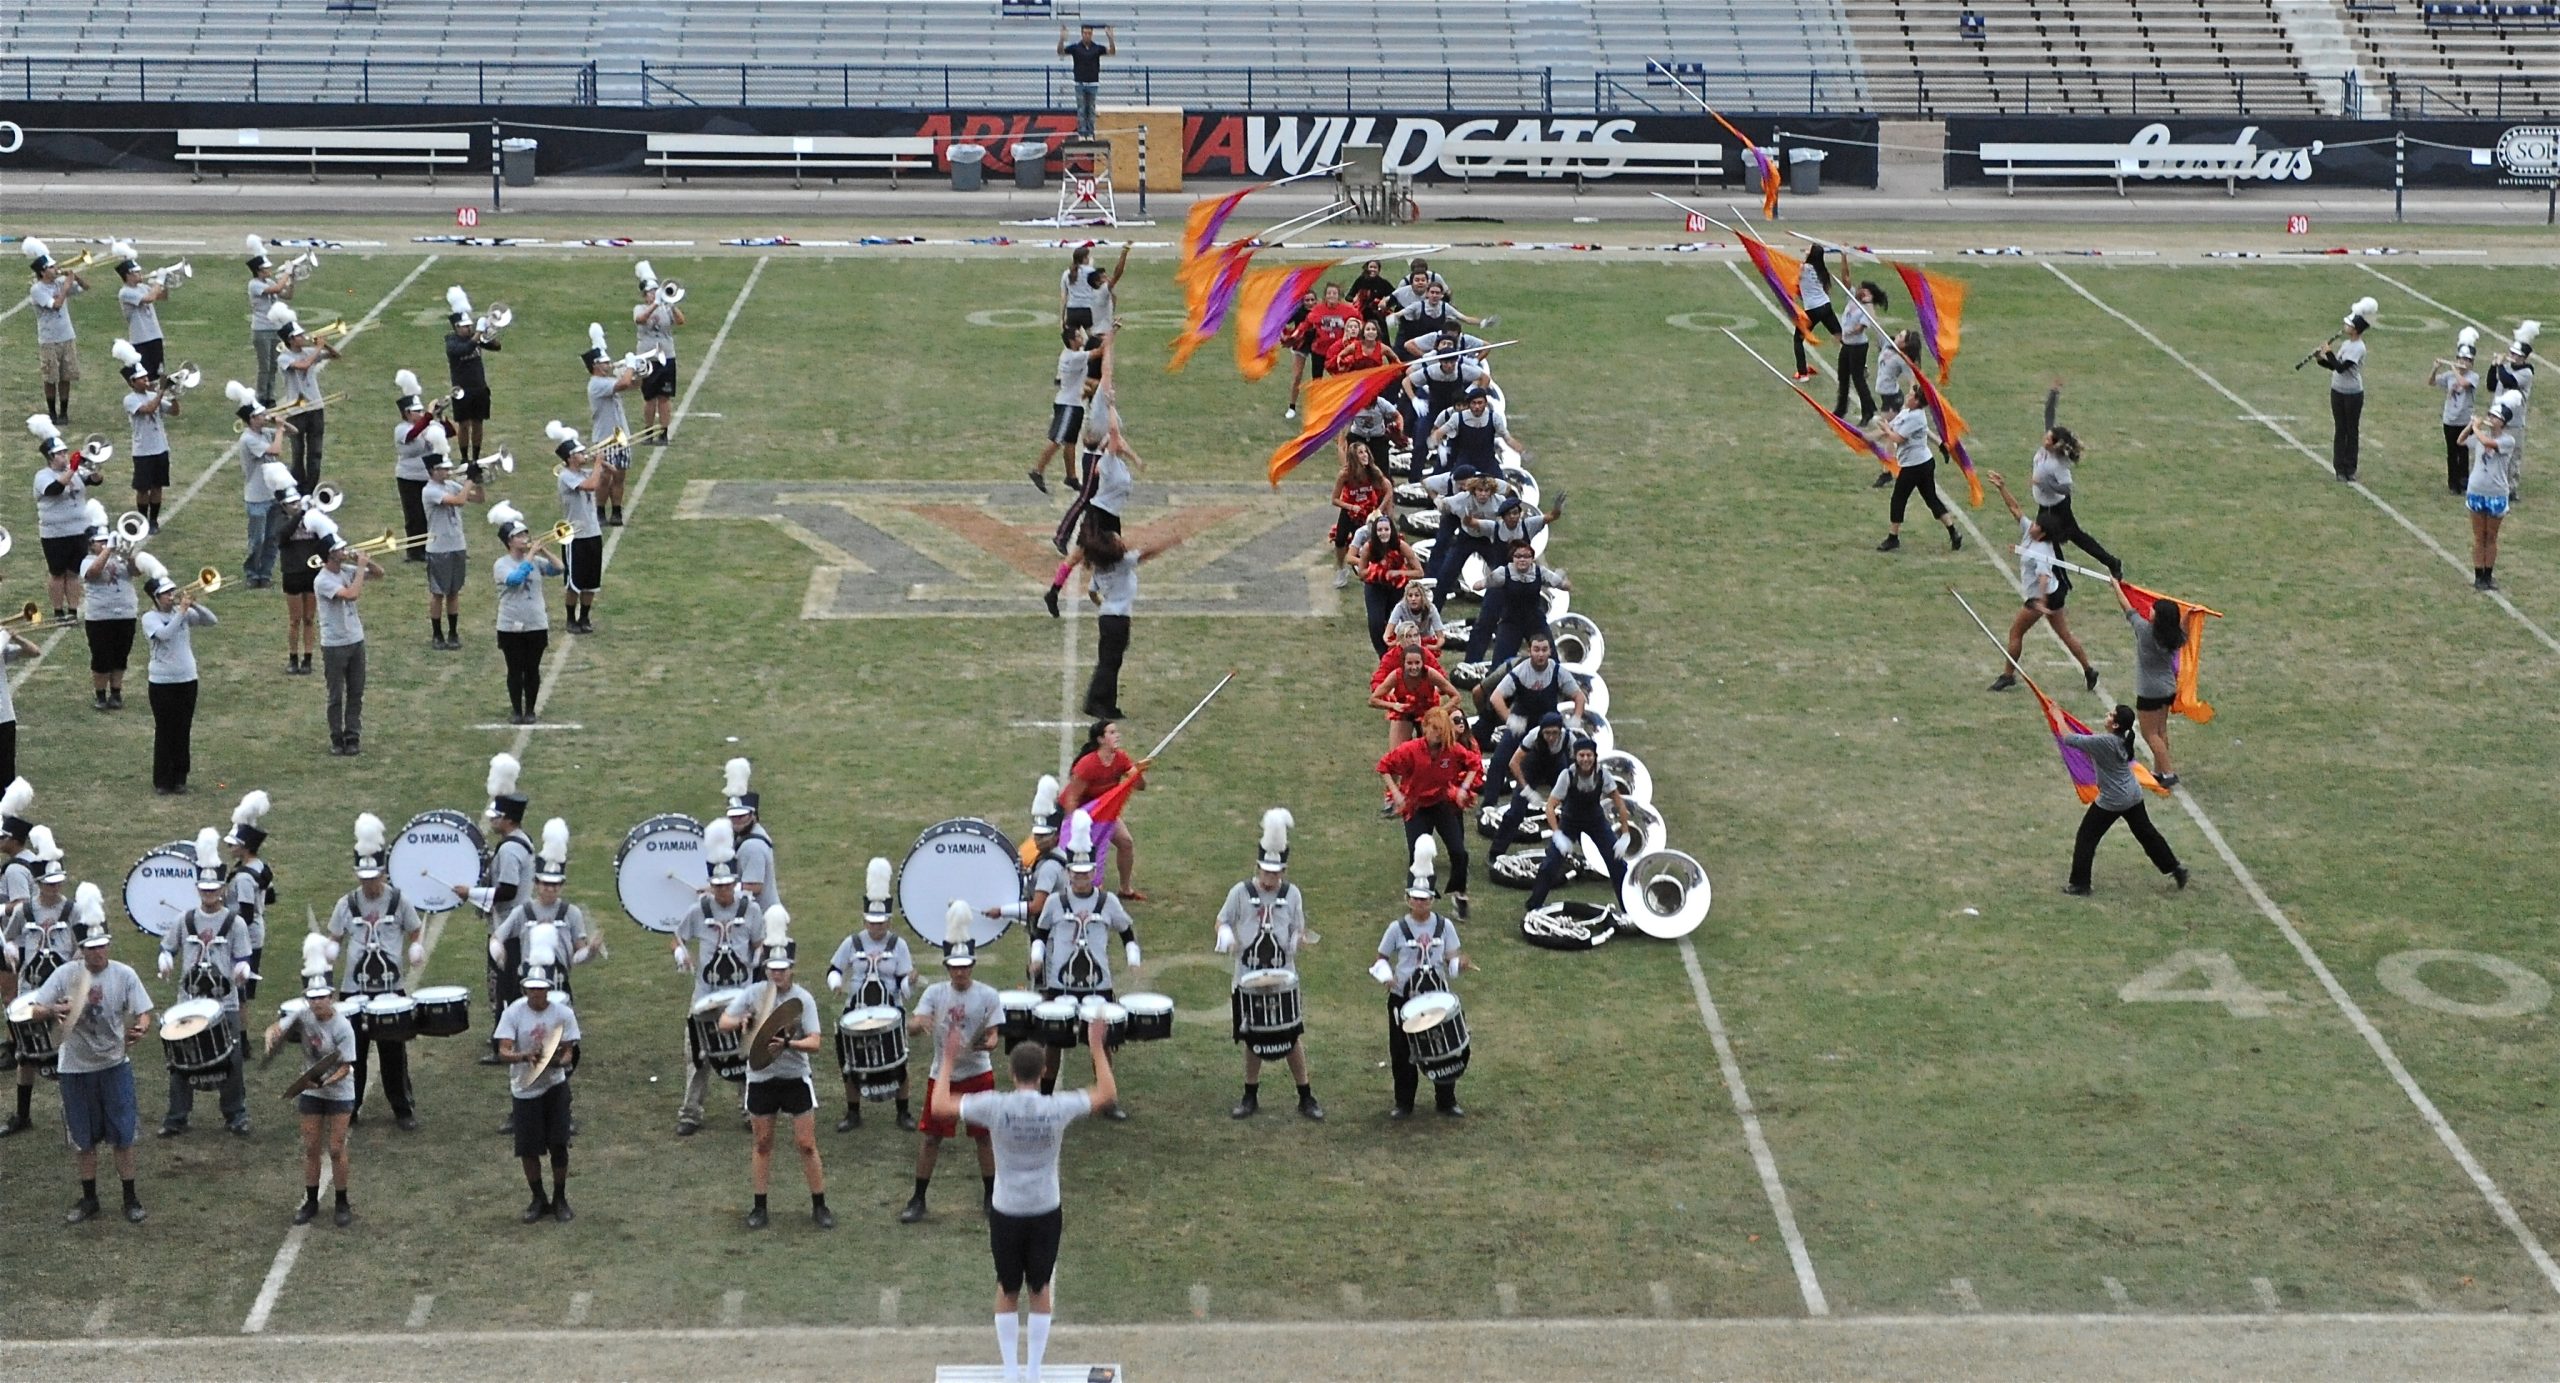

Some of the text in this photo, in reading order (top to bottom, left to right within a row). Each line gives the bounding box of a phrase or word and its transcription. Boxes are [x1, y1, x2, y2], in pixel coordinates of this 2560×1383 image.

[895, 114, 1247, 175] ARIZA
[1077, 178, 1095, 197] 50
[458, 208, 477, 226] 40
[1689, 213, 1706, 232] 40
[2289, 215, 2308, 234] 30
[419, 832, 460, 844] YAMAHA
[658, 840, 698, 852] YAMAHA
[947, 843, 987, 854] YAMAHA
[154, 867, 194, 879] YAMAHA
[1262, 1041, 1292, 1054] YAMAHA
[1436, 1060, 1465, 1078] YAMAHA
